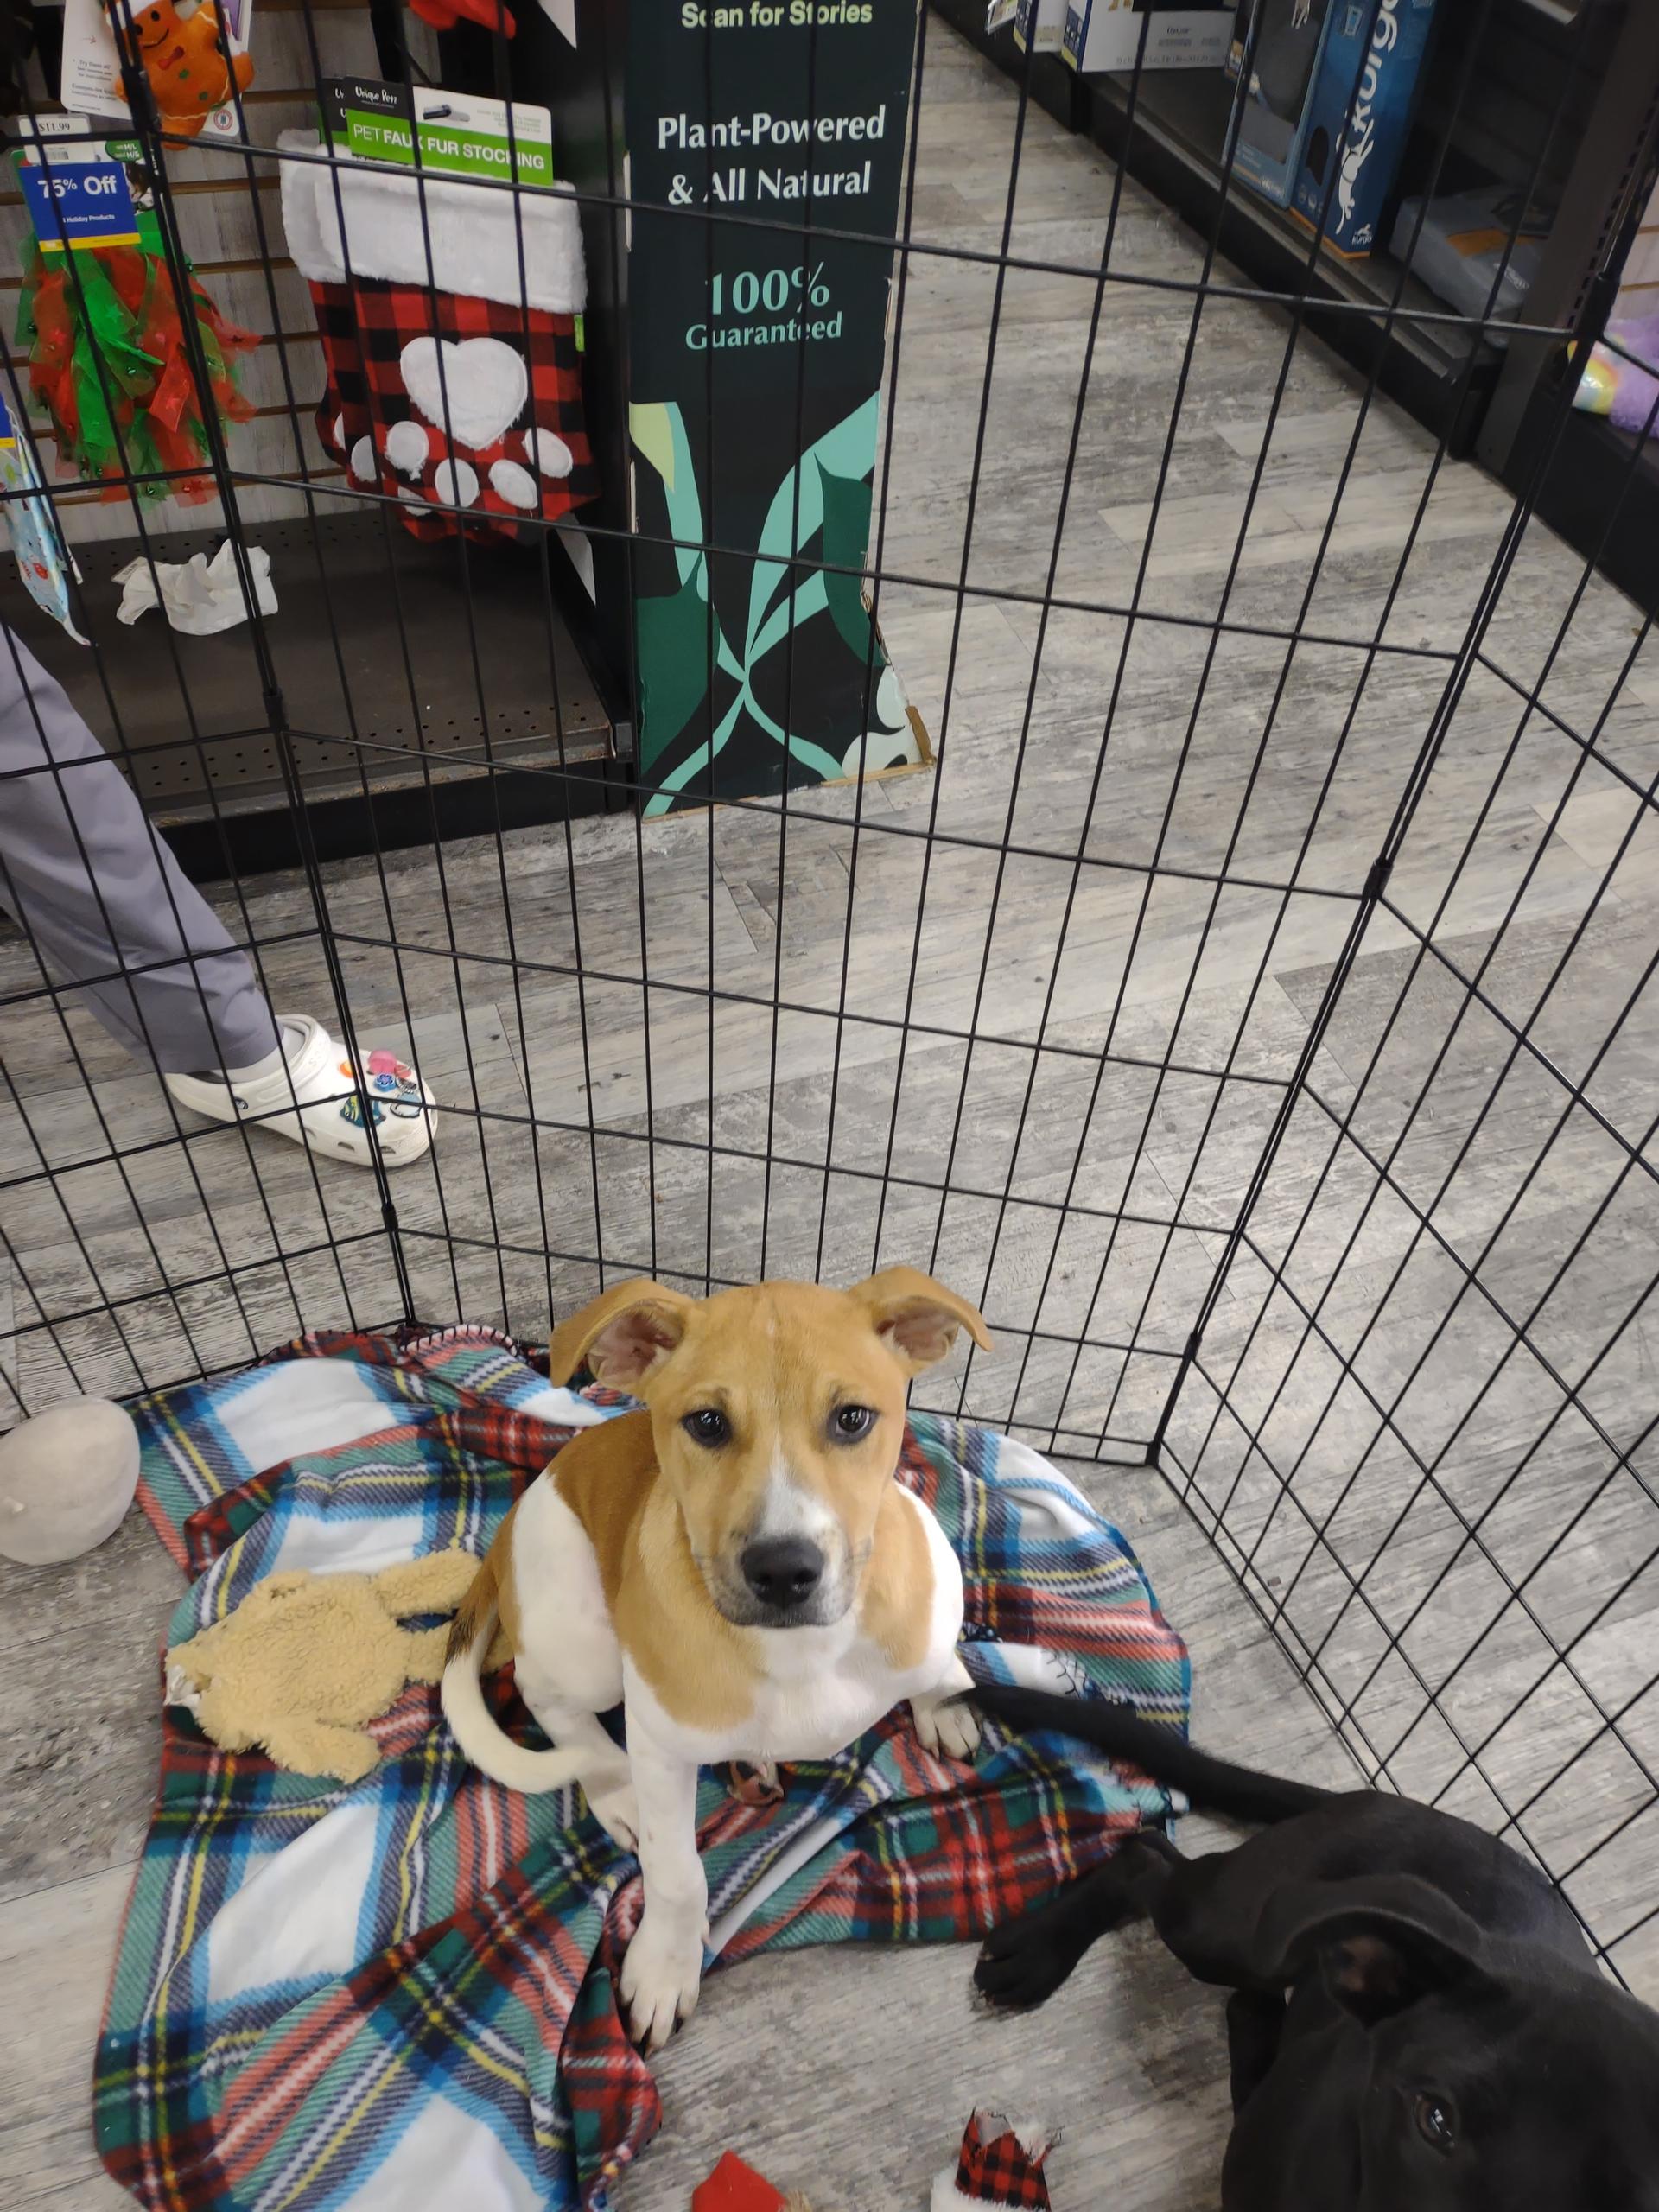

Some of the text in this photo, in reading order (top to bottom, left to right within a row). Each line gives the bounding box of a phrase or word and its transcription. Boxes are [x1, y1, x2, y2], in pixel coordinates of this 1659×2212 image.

[681, 0, 874, 29] Scan for Stories
[39, 122, 71, 132] $11.99
[353, 124, 381, 142] PET
[427, 137, 459, 156] FUR
[658, 105, 887, 149] Plant-Powered
[37, 175, 117, 199] 75% Off
[667, 161, 872, 206] & All Natural
[88, 213, 116, 222] Products
[705, 261, 830, 315] 100%
[685, 311, 843, 351] Guaranteed
